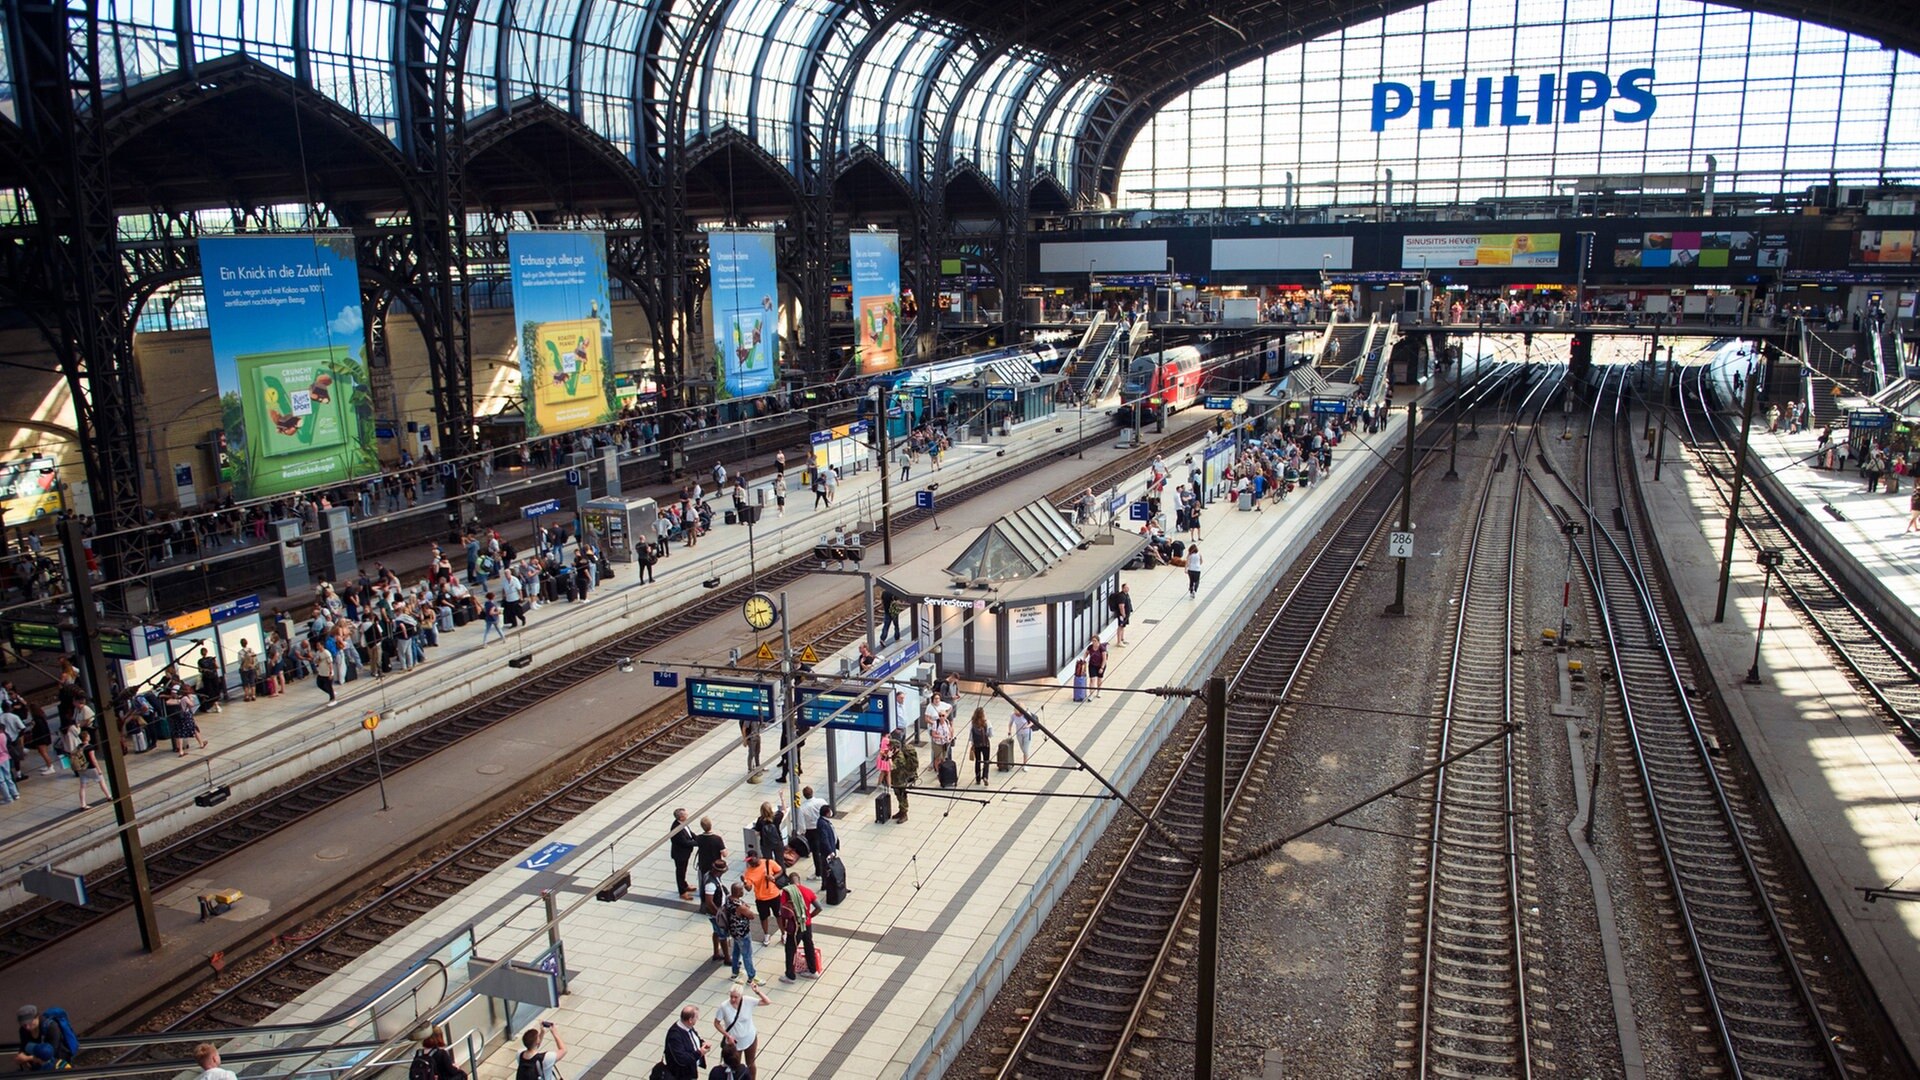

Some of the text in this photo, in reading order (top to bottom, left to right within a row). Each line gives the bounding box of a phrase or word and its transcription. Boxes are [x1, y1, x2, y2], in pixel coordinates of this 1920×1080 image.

[1371, 68, 1658, 132] PHILIPS
[520, 253, 585, 268] Erdnuss gut, alles gut.
[220, 263, 333, 280] Ein Knick in die Zukunft.
[224, 289, 242, 297] Lecker,
[225, 299, 251, 307] zertifiziert
[282, 367, 312, 377] CRUNCHY
[285, 375, 312, 383] MANDEL
[570, 471, 577, 483] D
[918, 492, 926, 506] E
[1132, 504, 1141, 518] E
[1393, 533, 1412, 544] 286
[1398, 545, 1405, 554] 6
[924, 596, 973, 608] ServiceStore
[696, 684, 701, 693] 7
[877, 699, 883, 709] 8
